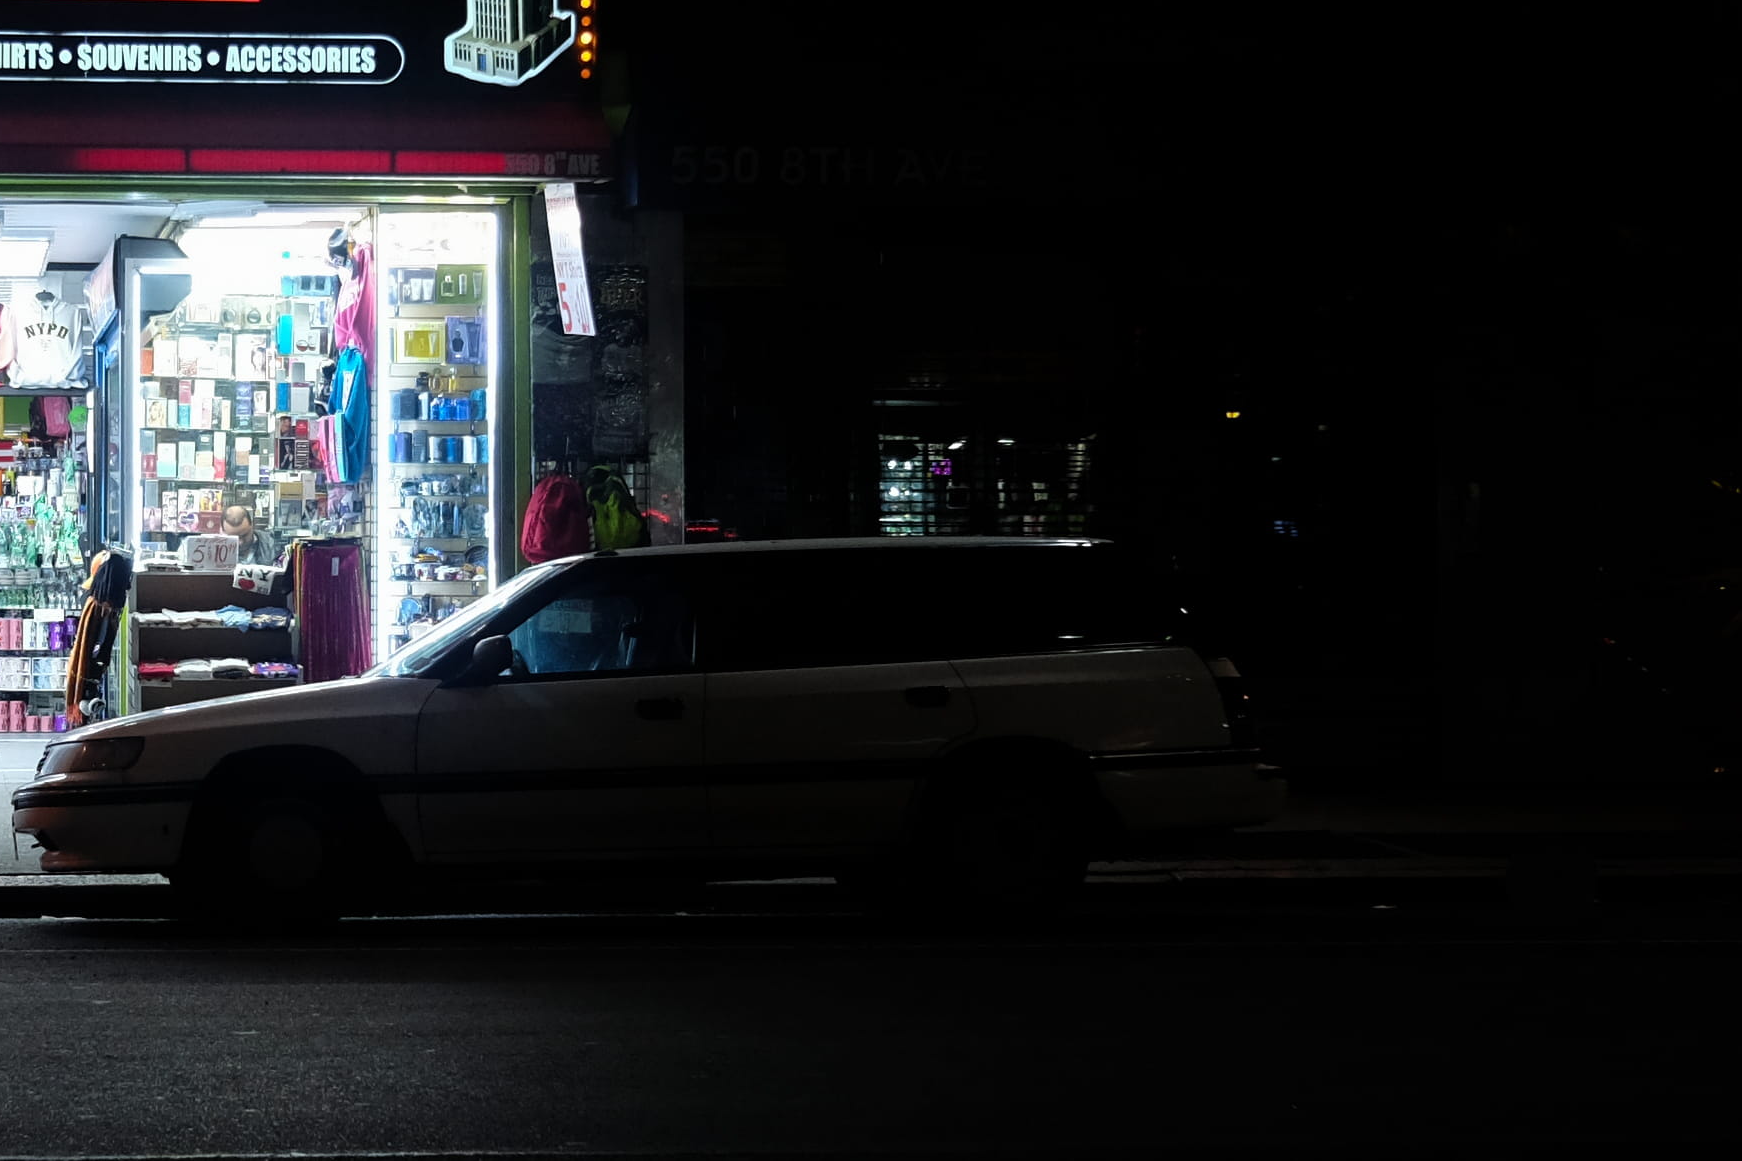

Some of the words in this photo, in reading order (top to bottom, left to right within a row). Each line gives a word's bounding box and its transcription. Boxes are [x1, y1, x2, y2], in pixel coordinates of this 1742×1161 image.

[77, 42, 202, 72] SOUVENIRS
[225, 45, 376, 74] ACCESSORIES
[567, 154, 600, 175] AVE
[670, 146, 761, 185] 550
[778, 147, 875, 186] 8TH
[893, 149, 990, 188] AVE
[25, 322, 70, 340] NYPD
[237, 568, 273, 582] NY
